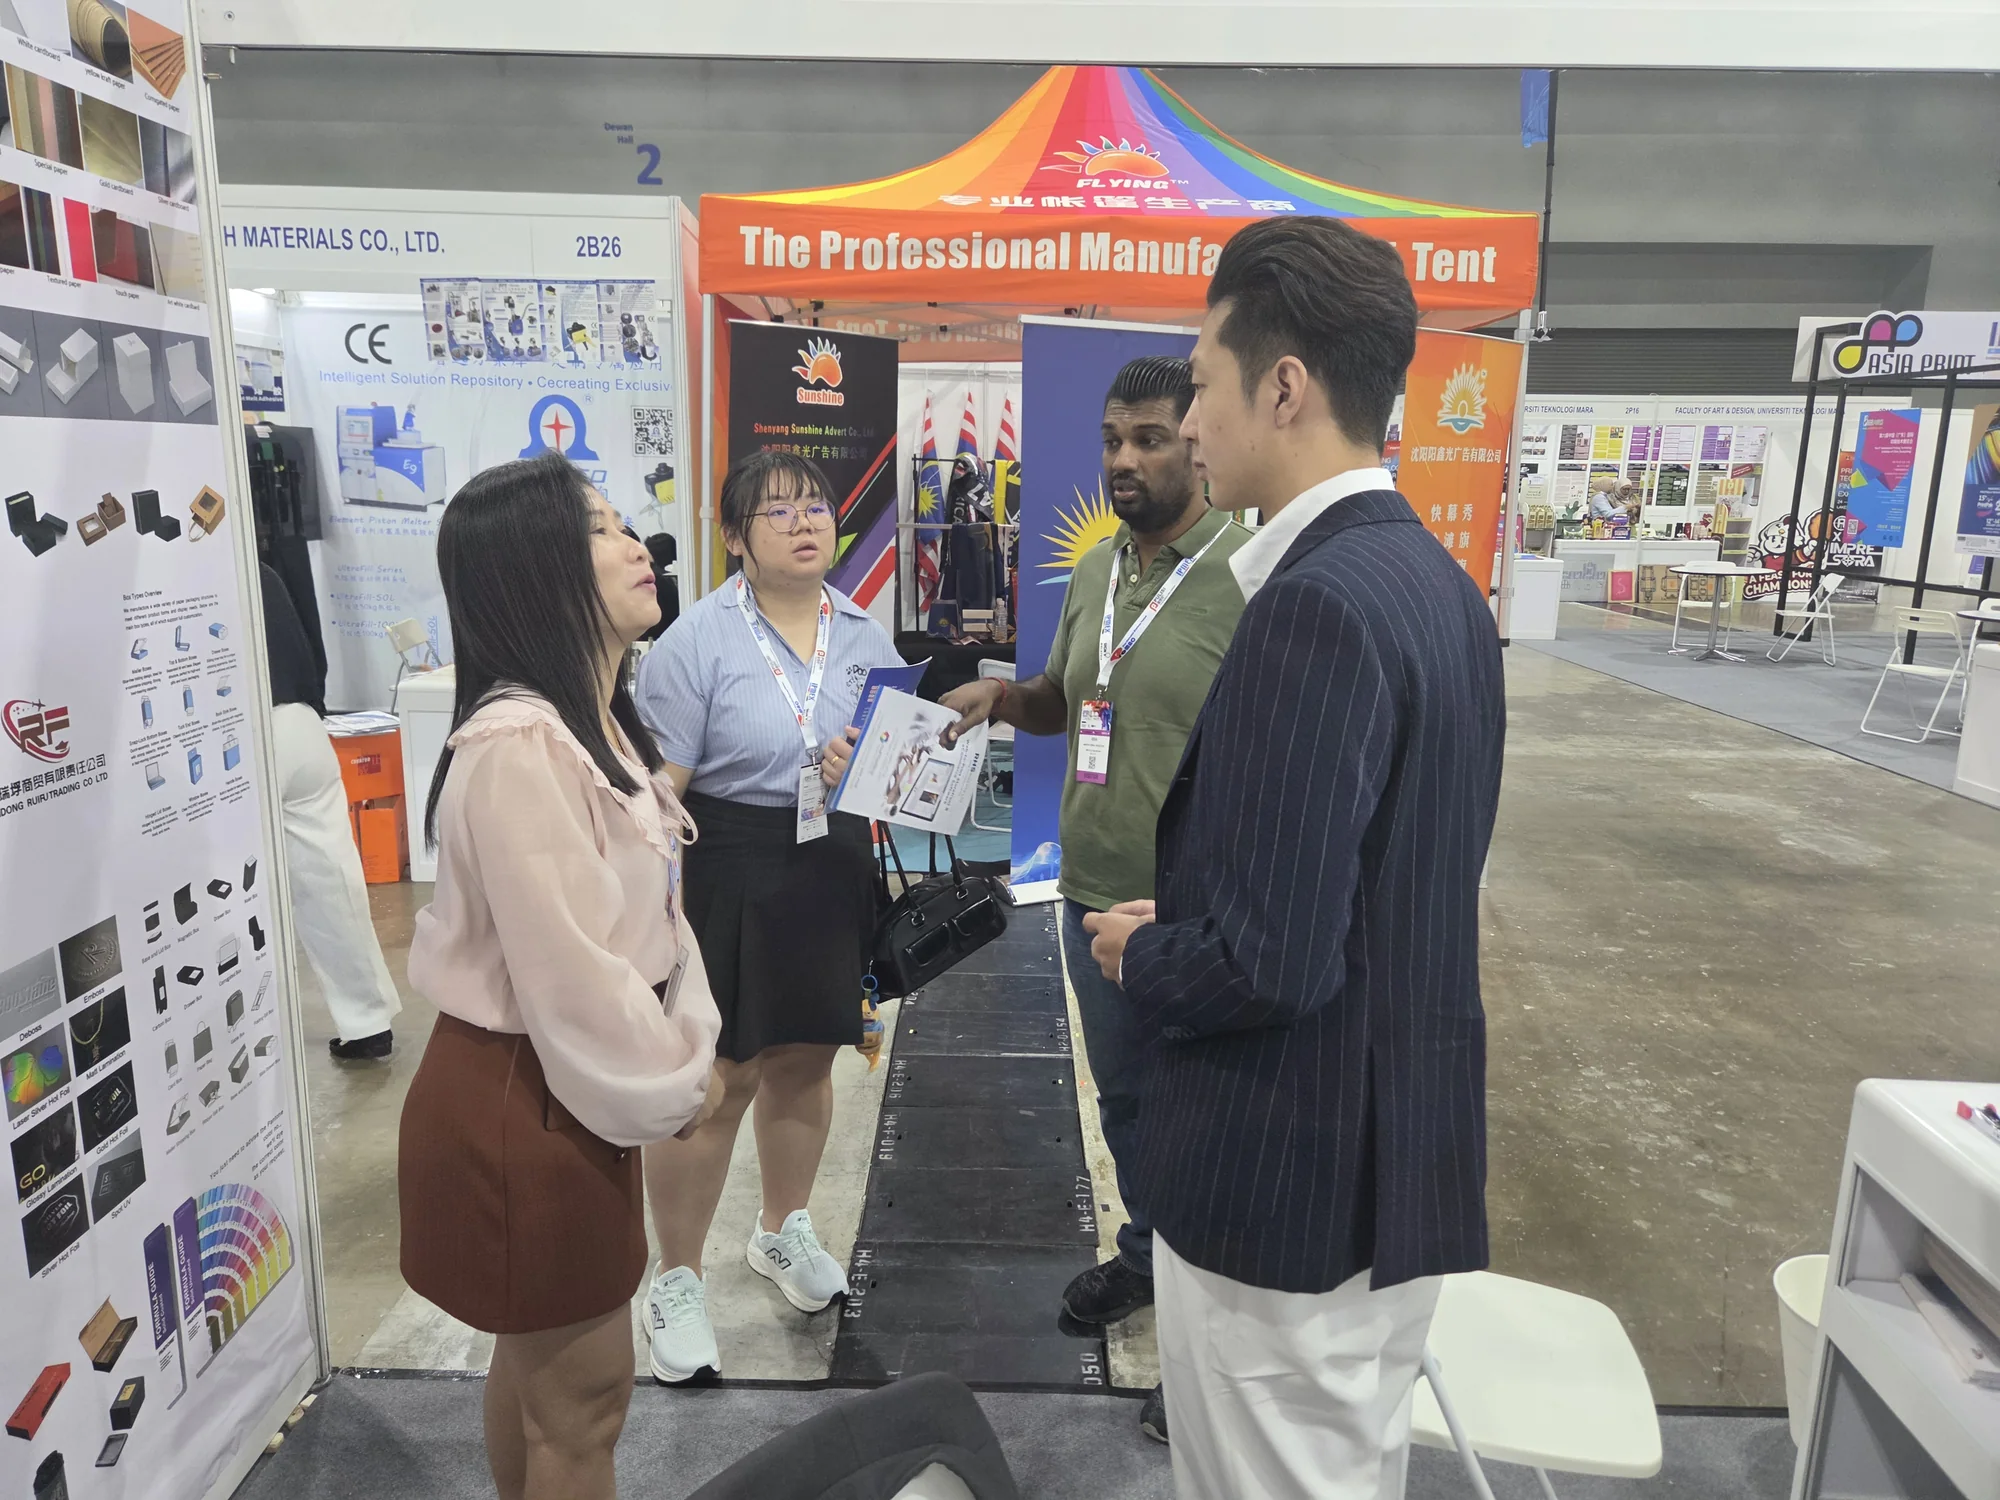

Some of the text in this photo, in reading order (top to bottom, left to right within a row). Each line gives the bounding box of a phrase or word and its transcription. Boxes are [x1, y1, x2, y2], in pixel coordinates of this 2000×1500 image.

[17, 37, 61, 62] White cardboard
[84, 68, 126, 90] yellow kraft paper
[144, 92, 181, 114] Corrugated paper
[603, 122, 634, 132] Dewan
[617, 136, 634, 144] Hall
[34, 158, 68, 176] Special paper
[637, 144, 663, 186] 2
[99, 179, 134, 196] Gold cardboard
[1077, 178, 1170, 190] FLYING
[158, 196, 190, 212] Silver cardboard
[242, 226, 354, 250] MATERIALS
[360, 229, 399, 256] CO.,
[405, 231, 445, 254] LTD.
[576, 236, 622, 258] 2B26
[739, 226, 1497, 284] The Professional Manufa Tent
[47, 275, 82, 288] Textured paper
[115, 289, 140, 300] Touch paper
[344, 323, 392, 365] CE
[1868, 354, 1913, 374] ASIA
[319, 370, 387, 386] Intelligent
[391, 372, 446, 386] Solution
[450, 373, 524, 390] Repository
[537, 375, 610, 392] Cecreating
[797, 387, 844, 406] Sunshine
[1540, 406, 1576, 414] TEKNOLOGI
[1576, 406, 1594, 414] MARA
[1675, 406, 1702, 414] FACULTY
[1731, 407, 1756, 416] DESIGN,
[1757, 407, 1791, 415] UNIVERSITI
[754, 423, 789, 436] Shenyang
[791, 424, 823, 436] Sunshine
[824, 426, 847, 436] Advert
[1410, 446, 1502, 464] 沈阳阳鑫光广告有限公司
[402, 458, 418, 475] E9
[328, 515, 432, 526] Element Piston Melter
[1433, 530, 1470, 550] 滩旗
[1758, 572, 1783, 582] FEAS
[132, 592, 144, 600] Types
[144, 590, 162, 598] Overview
[1745, 580, 1812, 596] CHAMIONS
[83, 777, 94, 788] CO
[96, 772, 108, 784] LTD
[83, 987, 105, 1004] Emboss
[904, 992, 919, 1006] 204
[20, 1024, 42, 1042] Deboss
[86, 1050, 126, 1080] Matt Lamination
[12, 1086, 71, 1130] Laser Silver Hot Foil
[96, 1126, 129, 1155] Gold Hot Foil
[25, 1166, 78, 1208] Glossy Lamination
[110, 1198, 132, 1220] Spot UV
[41, 1242, 80, 1279] Silver Hot Foil
[177, 1235, 190, 1311] FORMULA GUIDE
[148, 1262, 162, 1342] FORMULA GUIDE
